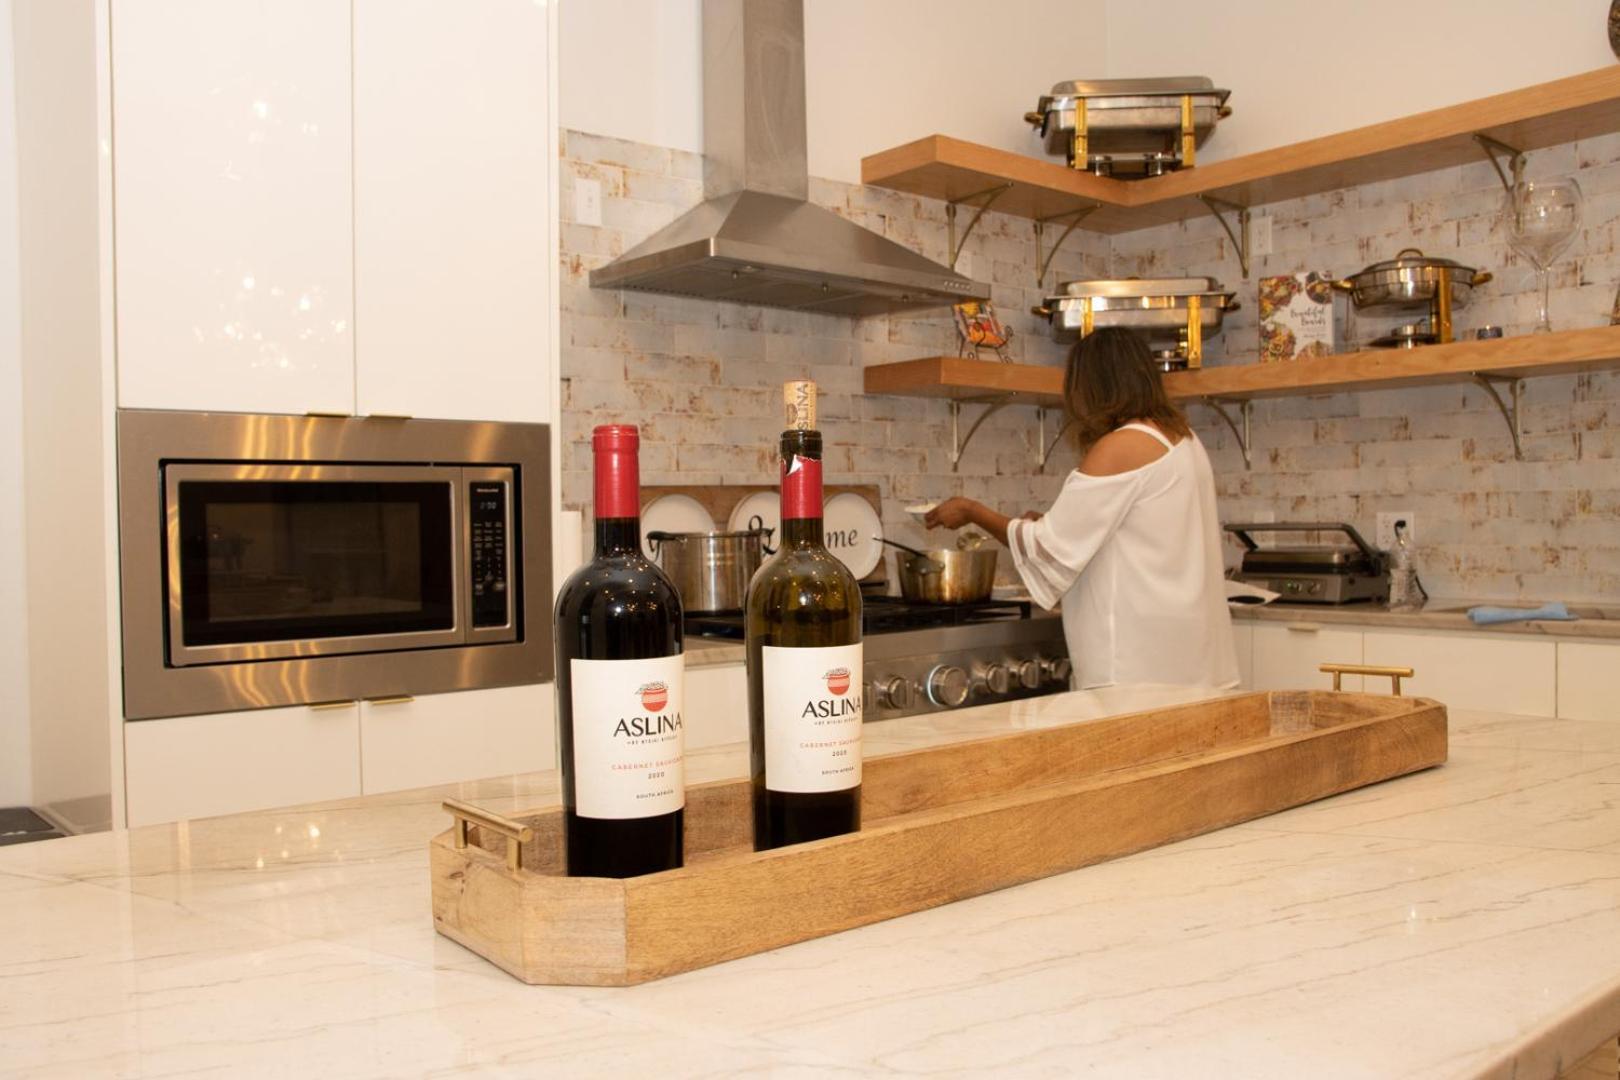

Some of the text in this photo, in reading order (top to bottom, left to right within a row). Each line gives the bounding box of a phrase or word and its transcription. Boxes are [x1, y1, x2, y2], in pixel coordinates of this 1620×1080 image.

[796, 383, 809, 430] SLINA
[826, 528, 858, 548] me
[802, 695, 862, 718] ASLINA
[613, 711, 683, 737] ASLINA
[648, 771, 665, 780] 2020
